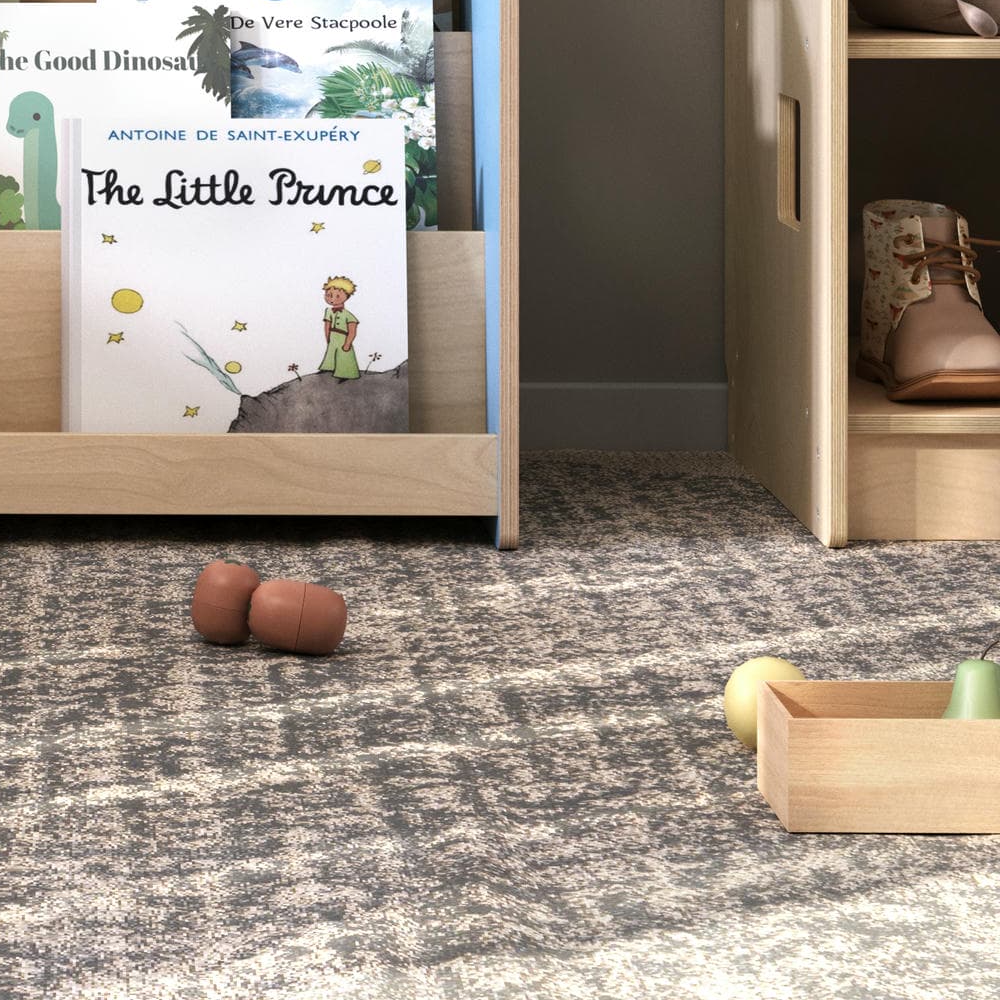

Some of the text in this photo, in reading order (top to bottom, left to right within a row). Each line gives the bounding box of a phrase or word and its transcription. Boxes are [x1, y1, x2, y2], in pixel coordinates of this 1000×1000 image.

[230, 15, 398, 33] De Vere Stacpoole
[34, 49, 97, 71] Good
[108, 125, 360, 142] ANTOINE DE SAINT-EXUPÉRY
[81, 167, 399, 209] The Little Prince
